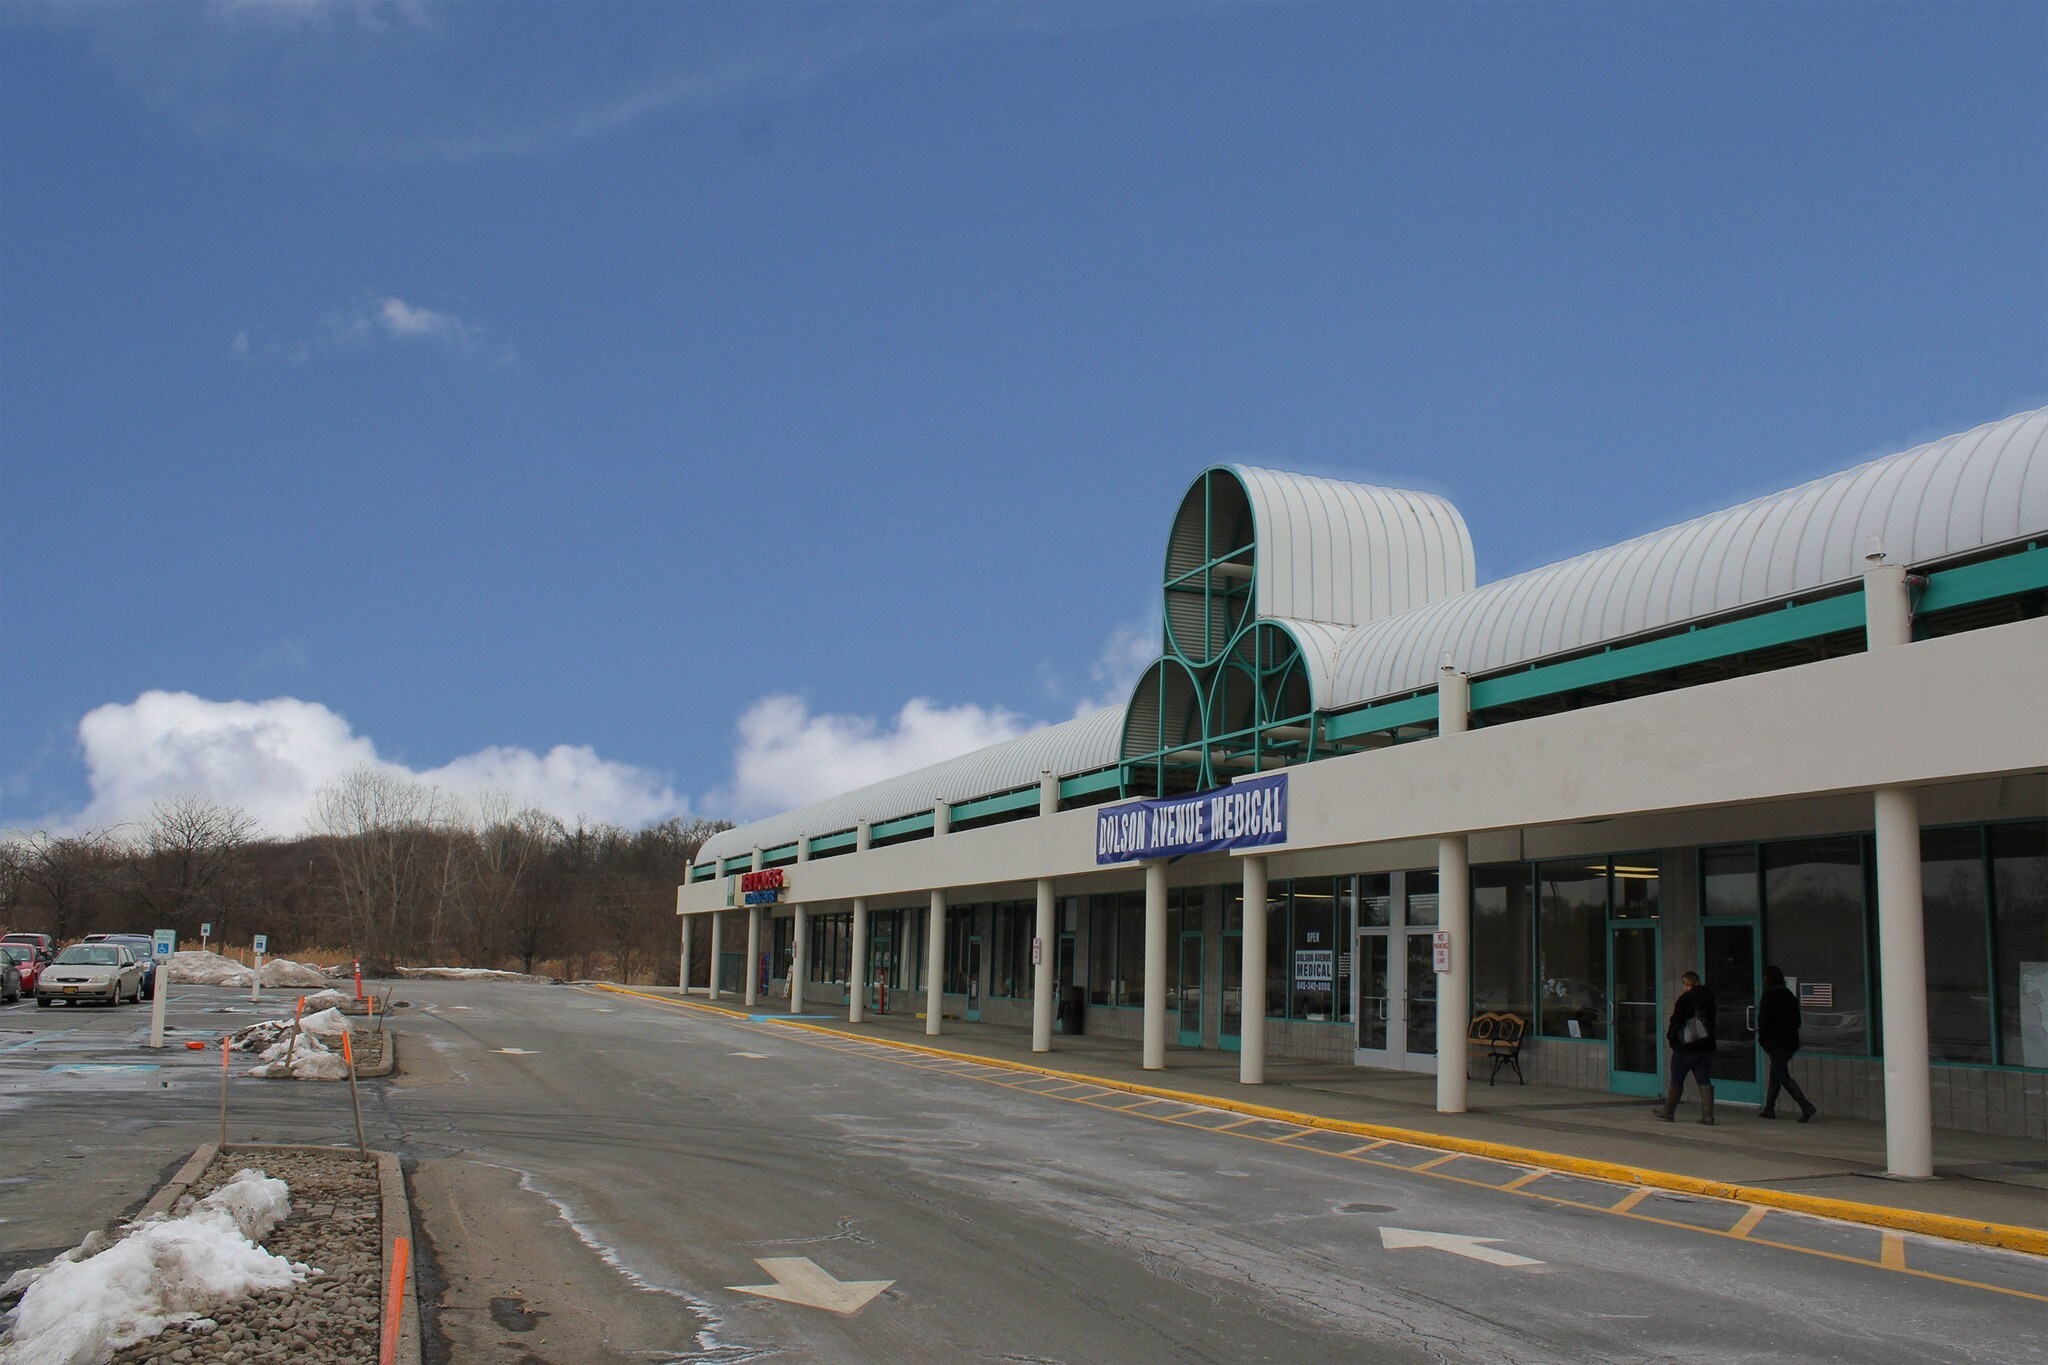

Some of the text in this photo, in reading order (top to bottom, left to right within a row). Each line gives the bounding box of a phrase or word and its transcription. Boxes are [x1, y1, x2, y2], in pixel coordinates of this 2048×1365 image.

[1099, 787, 1282, 855] DOLSON AVENUE MEDICAL
[1306, 932, 1319, 943] OPEN
[1437, 934, 1444, 942] NO
[1296, 953, 1332, 962] DOLSON AVENUE
[1296, 963, 1331, 977] MEDICAL
